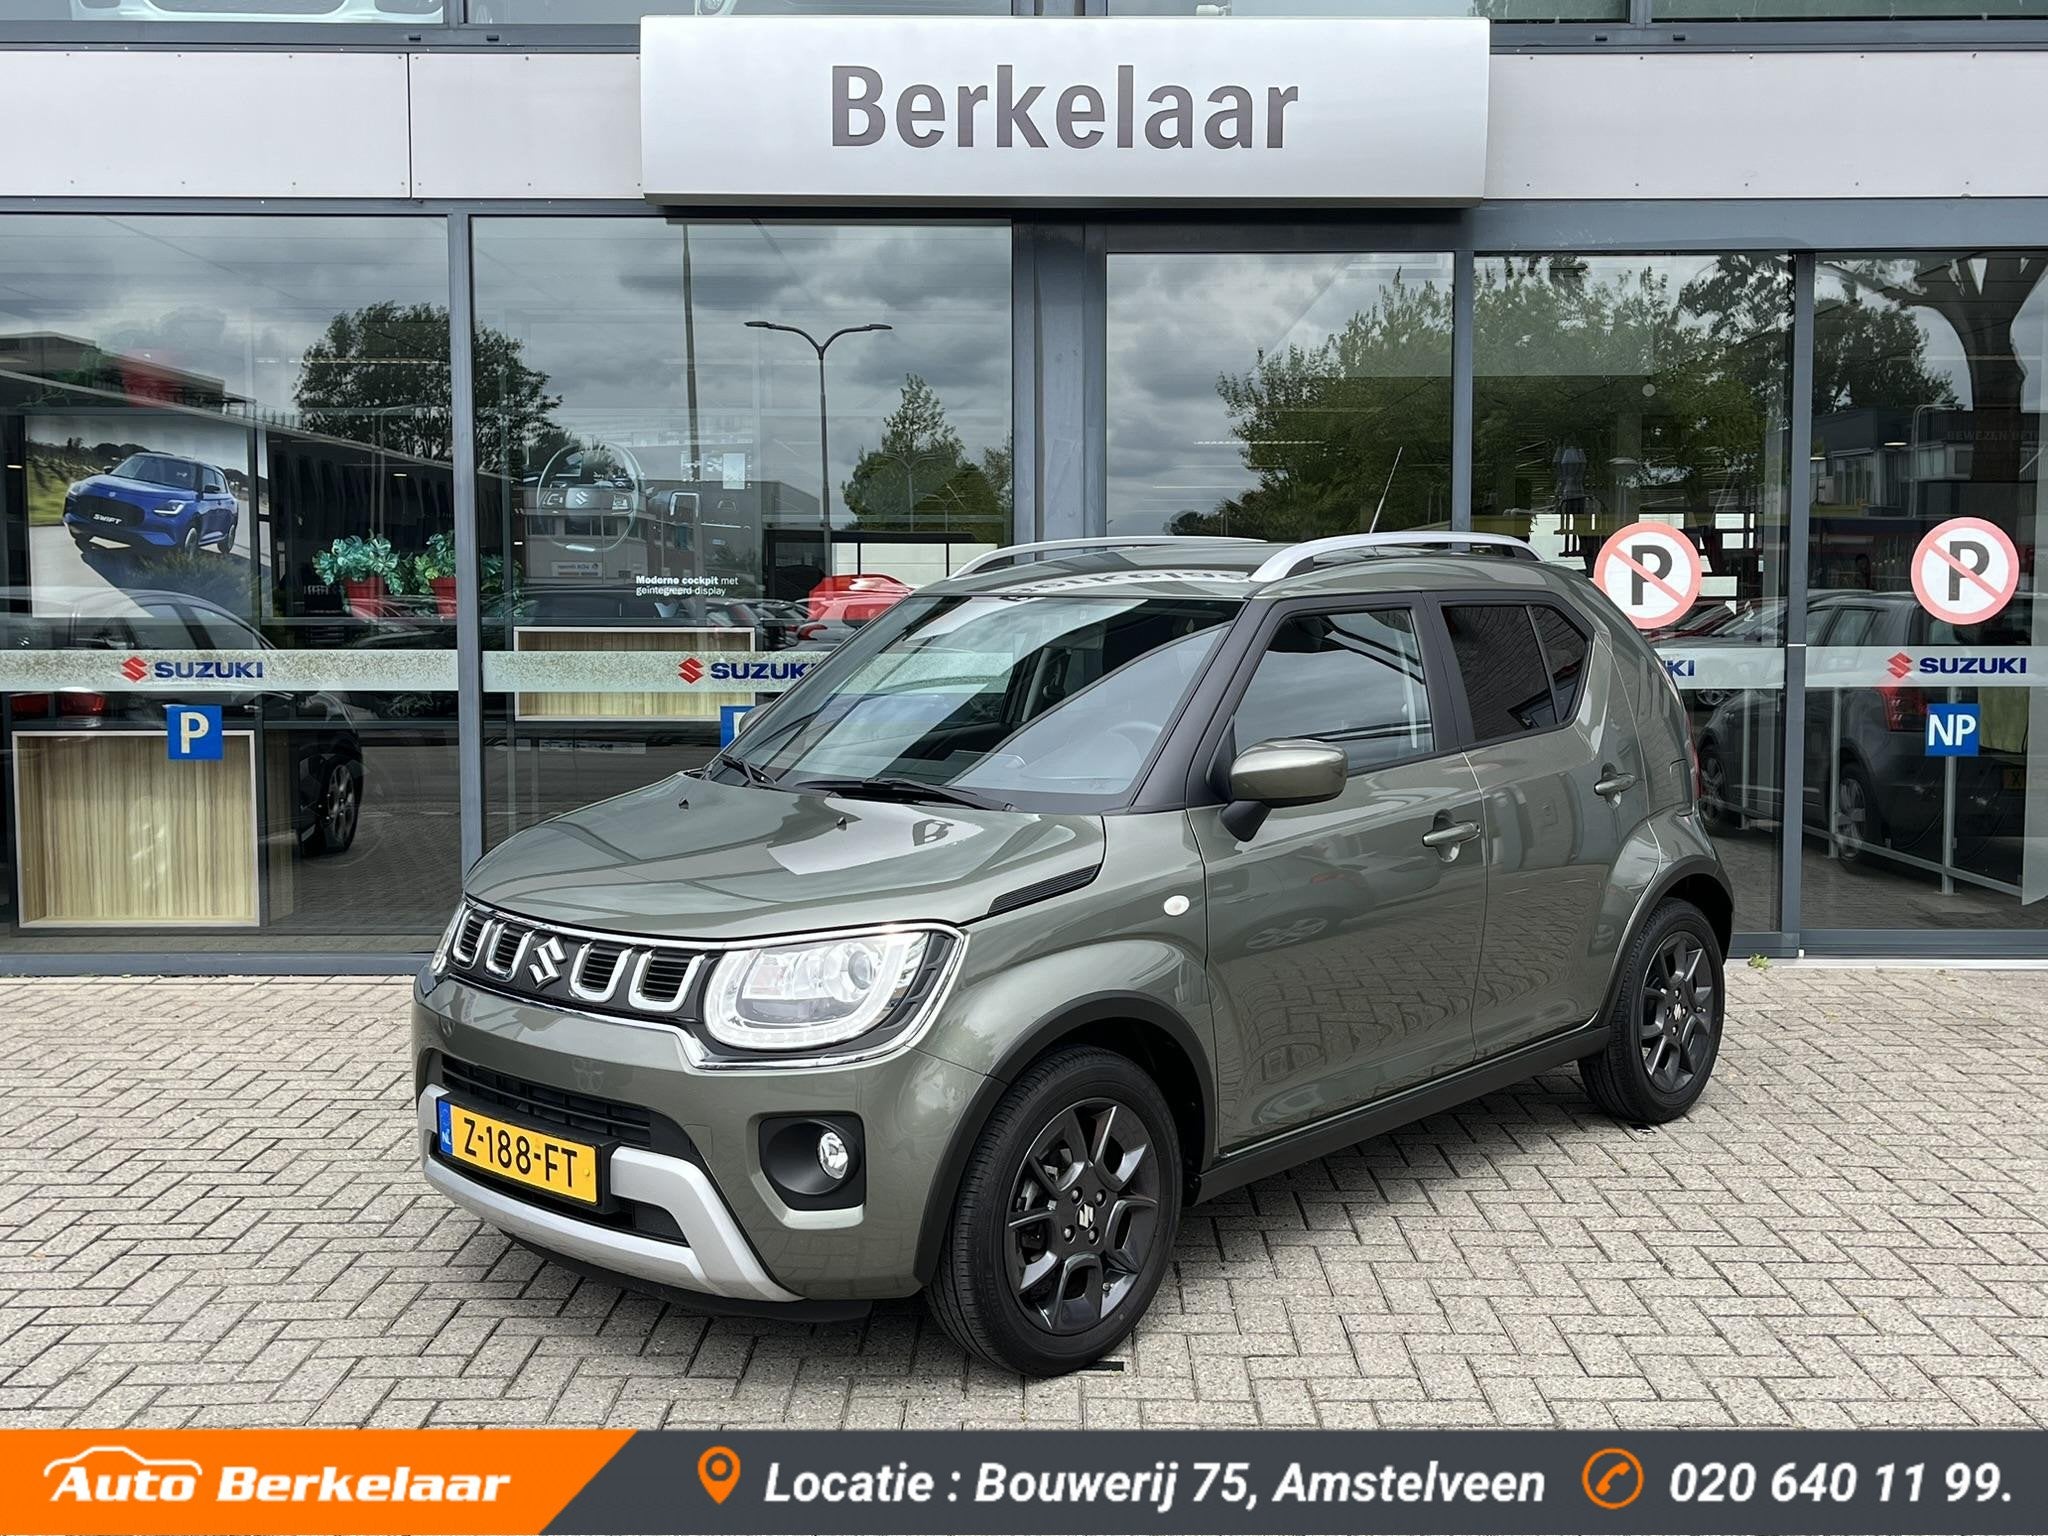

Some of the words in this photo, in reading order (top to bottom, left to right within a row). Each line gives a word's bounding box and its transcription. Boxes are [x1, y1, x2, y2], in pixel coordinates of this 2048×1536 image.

[833, 65, 1298, 149] Berkelaar
[636, 575, 679, 585] Moderne
[682, 575, 718, 587] cockpit
[721, 577, 739, 585] met
[694, 586, 727, 597] display
[154, 661, 263, 679] SUZUKI
[711, 662, 816, 680] SUZUK
[1919, 657, 2027, 674] SUZUKI
[181, 712, 209, 753] P
[1929, 714, 1977, 746] NP
[463, 1117, 578, 1188] Z-188-FT
